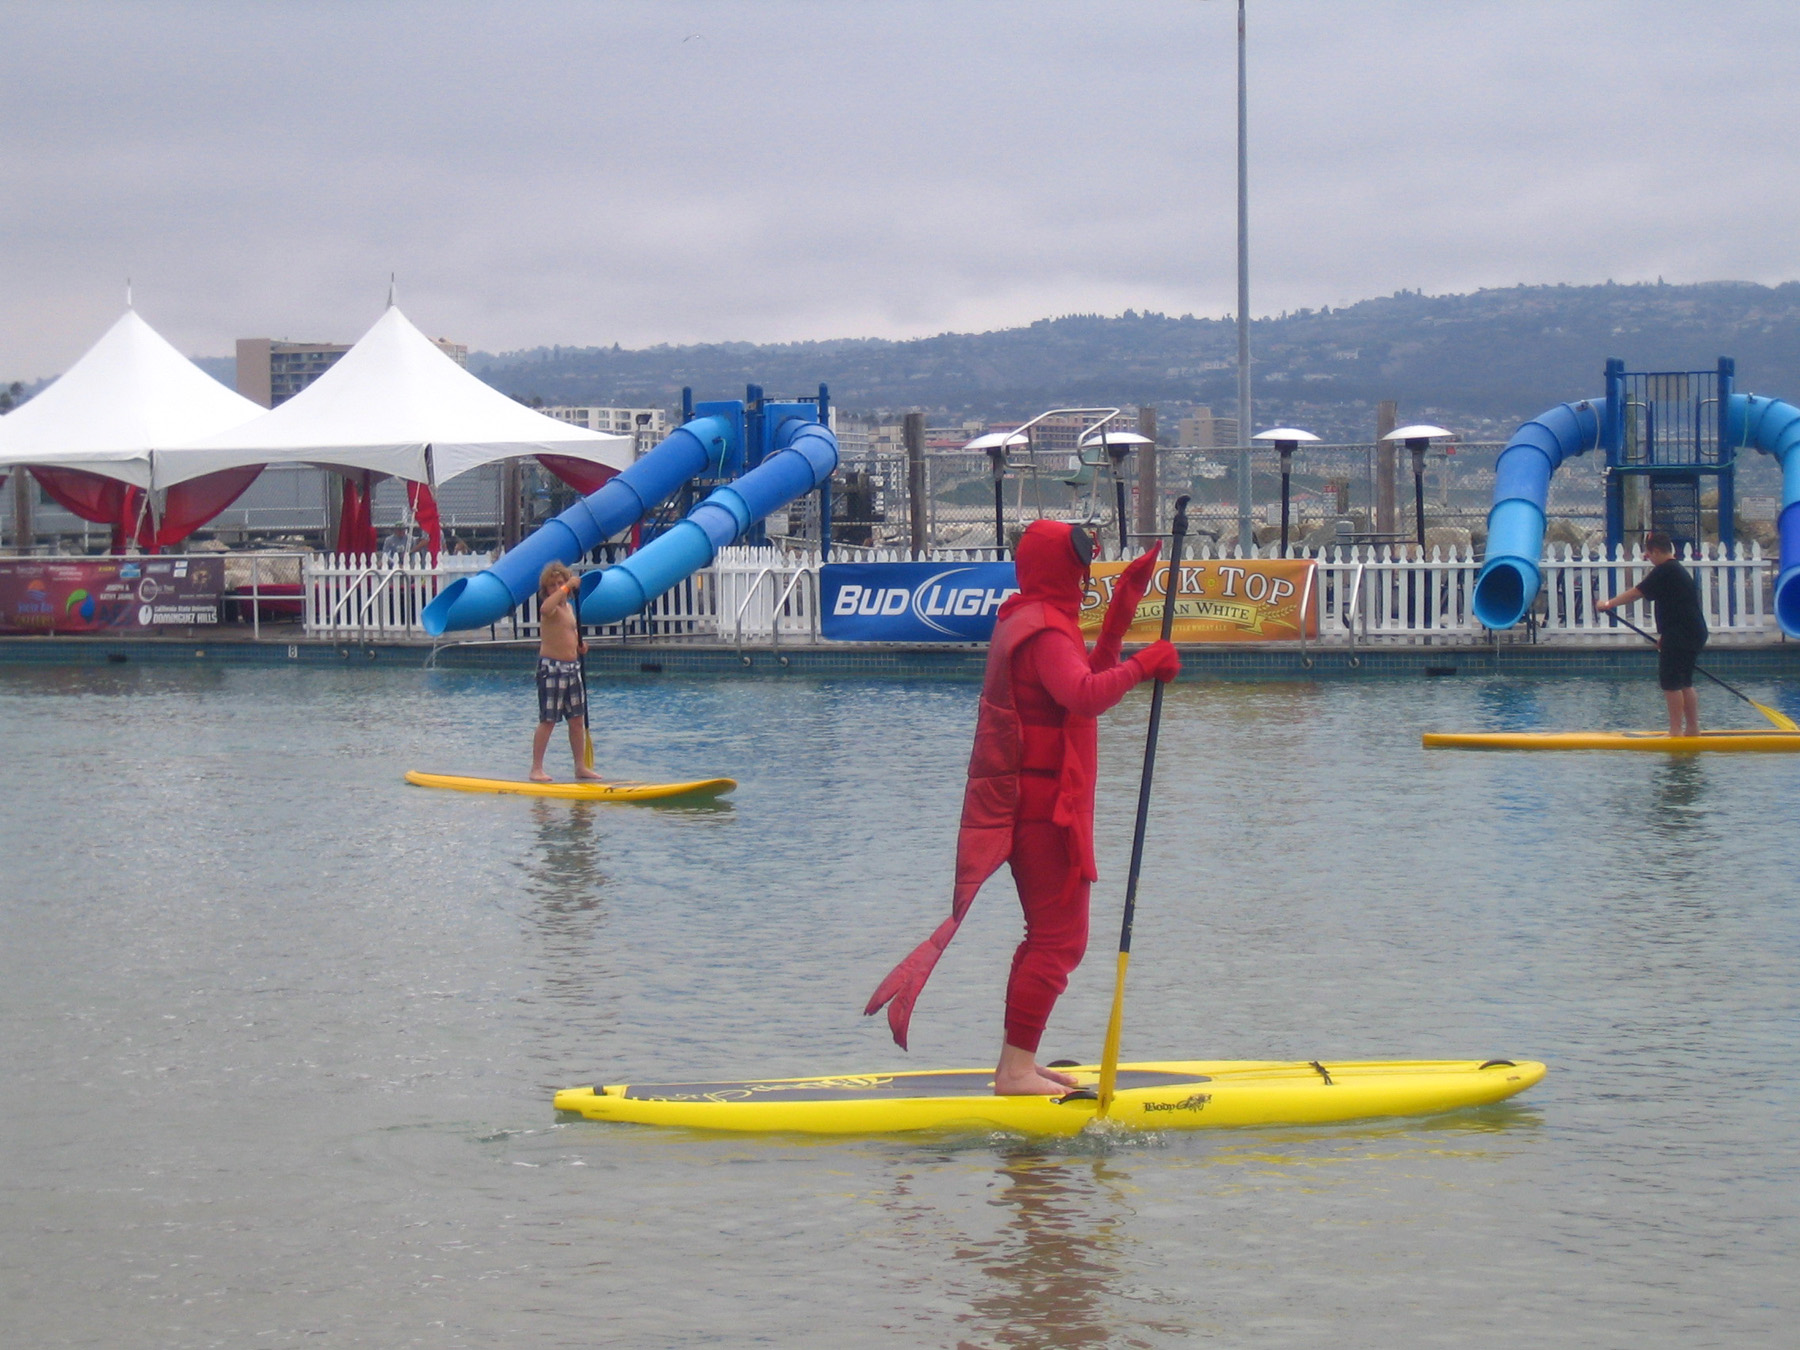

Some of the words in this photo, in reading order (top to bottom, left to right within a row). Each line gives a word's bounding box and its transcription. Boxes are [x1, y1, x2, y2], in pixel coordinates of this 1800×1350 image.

[1218, 566, 1295, 605] TOP
[833, 585, 910, 616] BUD
[925, 585, 1021, 616] LIGH
[1196, 601, 1250, 620] WHITE
[153, 613, 196, 624] DOMINGUEZ
[197, 612, 218, 624] HILLS
